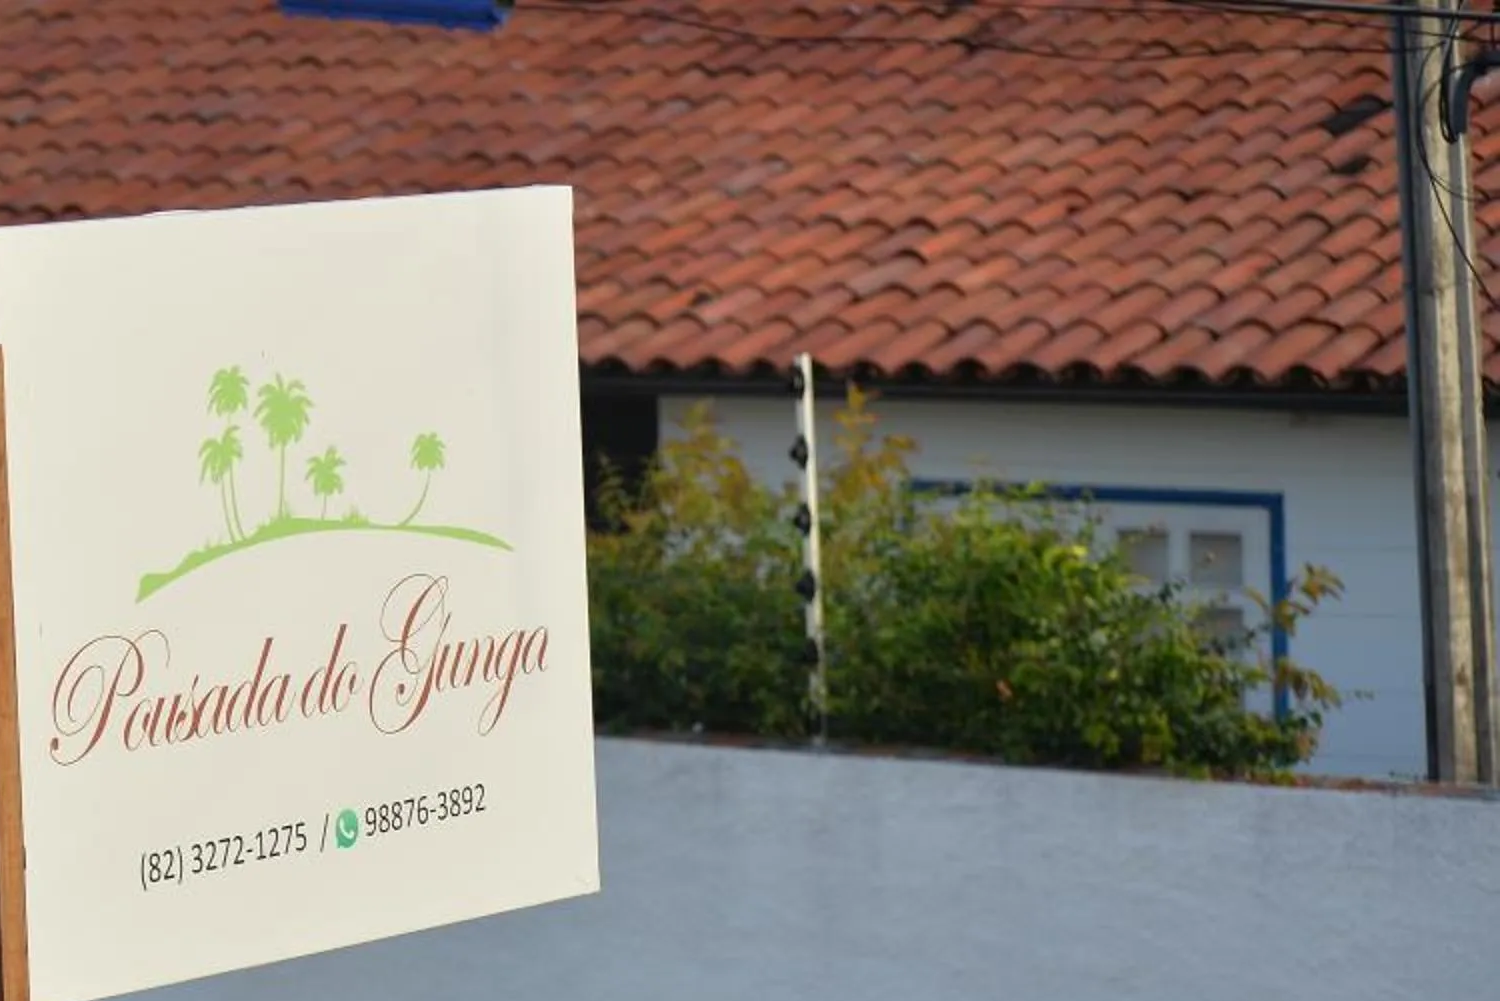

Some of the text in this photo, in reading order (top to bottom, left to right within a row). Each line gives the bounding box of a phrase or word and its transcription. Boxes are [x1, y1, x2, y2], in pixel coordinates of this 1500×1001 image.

[50, 572, 549, 767] Pousada do Gunga
[140, 846, 184, 890] (82)
[190, 821, 309, 875] 3272-1275
[364, 783, 487, 838] 98876-3892
